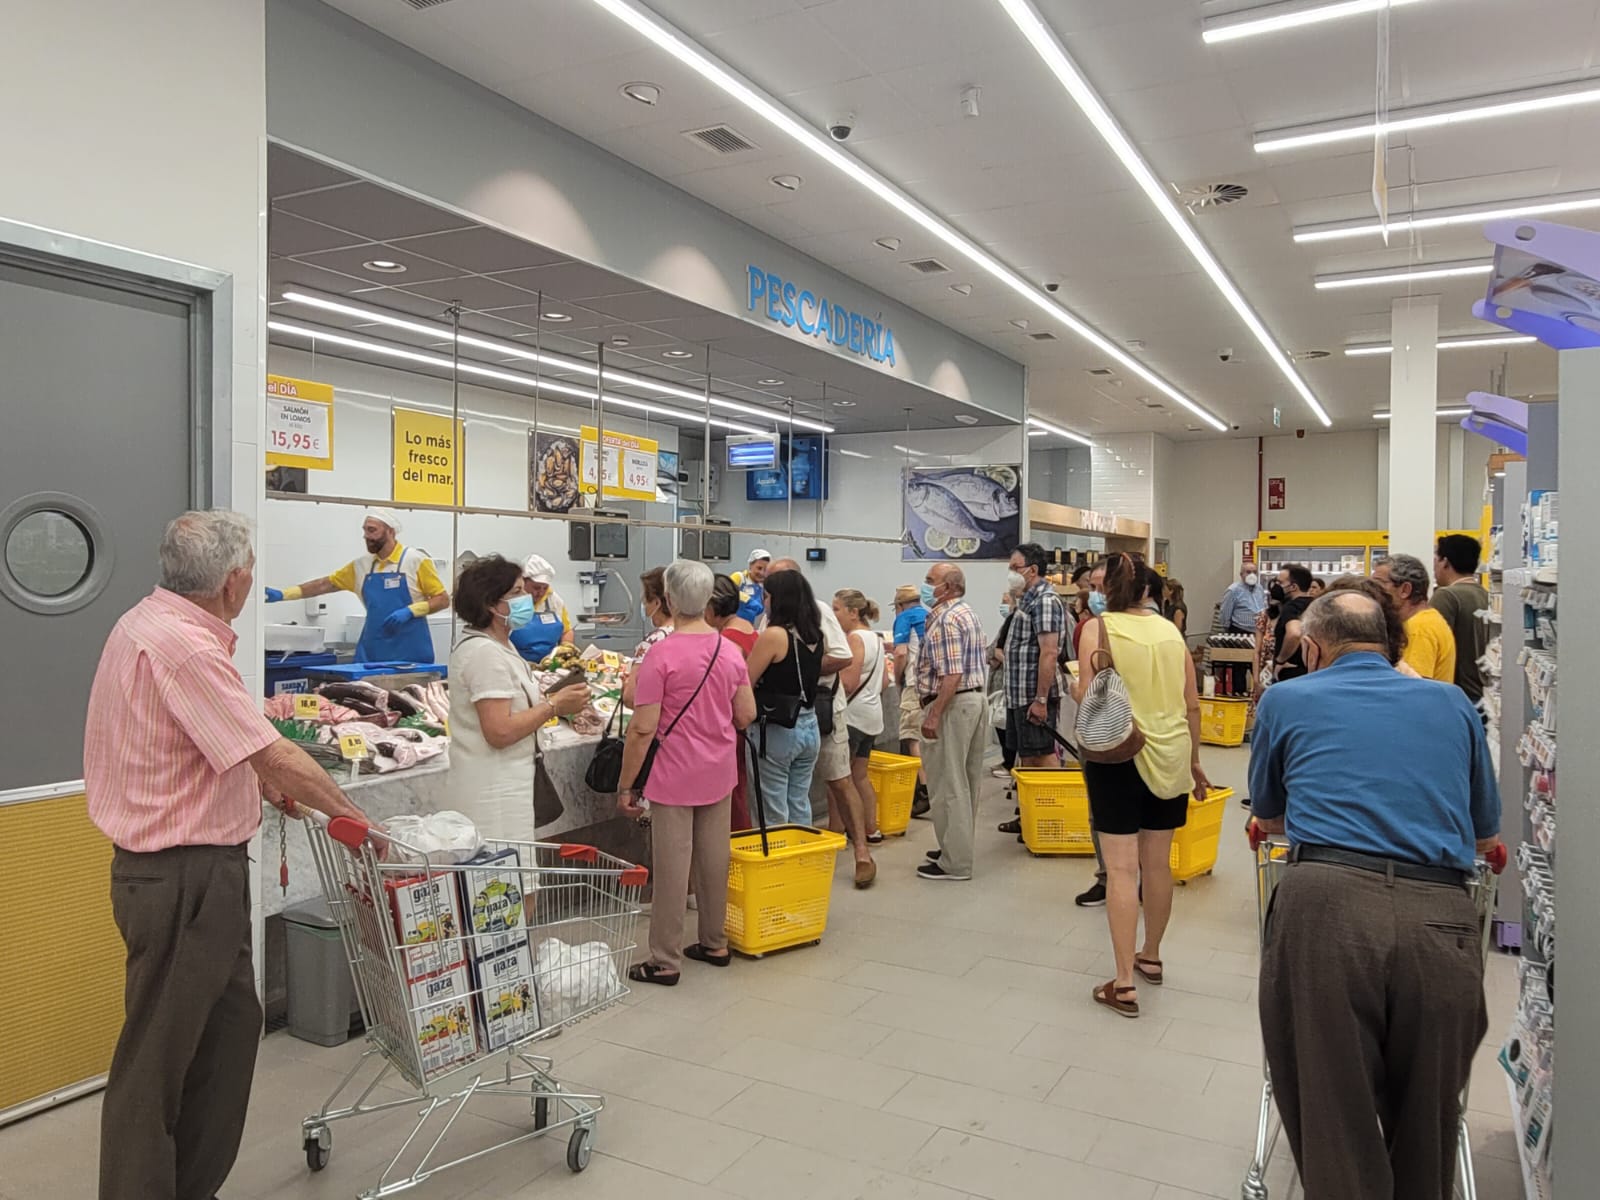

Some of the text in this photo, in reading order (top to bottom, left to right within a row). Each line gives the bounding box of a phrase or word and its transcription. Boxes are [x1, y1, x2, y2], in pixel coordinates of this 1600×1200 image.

[746, 264, 896, 368] PESCADERÍA
[280, 382, 298, 395] DÍA
[280, 412, 311, 424] EN LOMOS
[283, 405, 309, 415] SALMÓN
[405, 430, 451, 449] Lo más
[408, 449, 448, 467] fresco
[402, 467, 454, 486] del mar.
[413, 883, 440, 903] gaza
[486, 898, 509, 917] gaza
[493, 956, 517, 976] gaza
[426, 977, 452, 998] gaza
